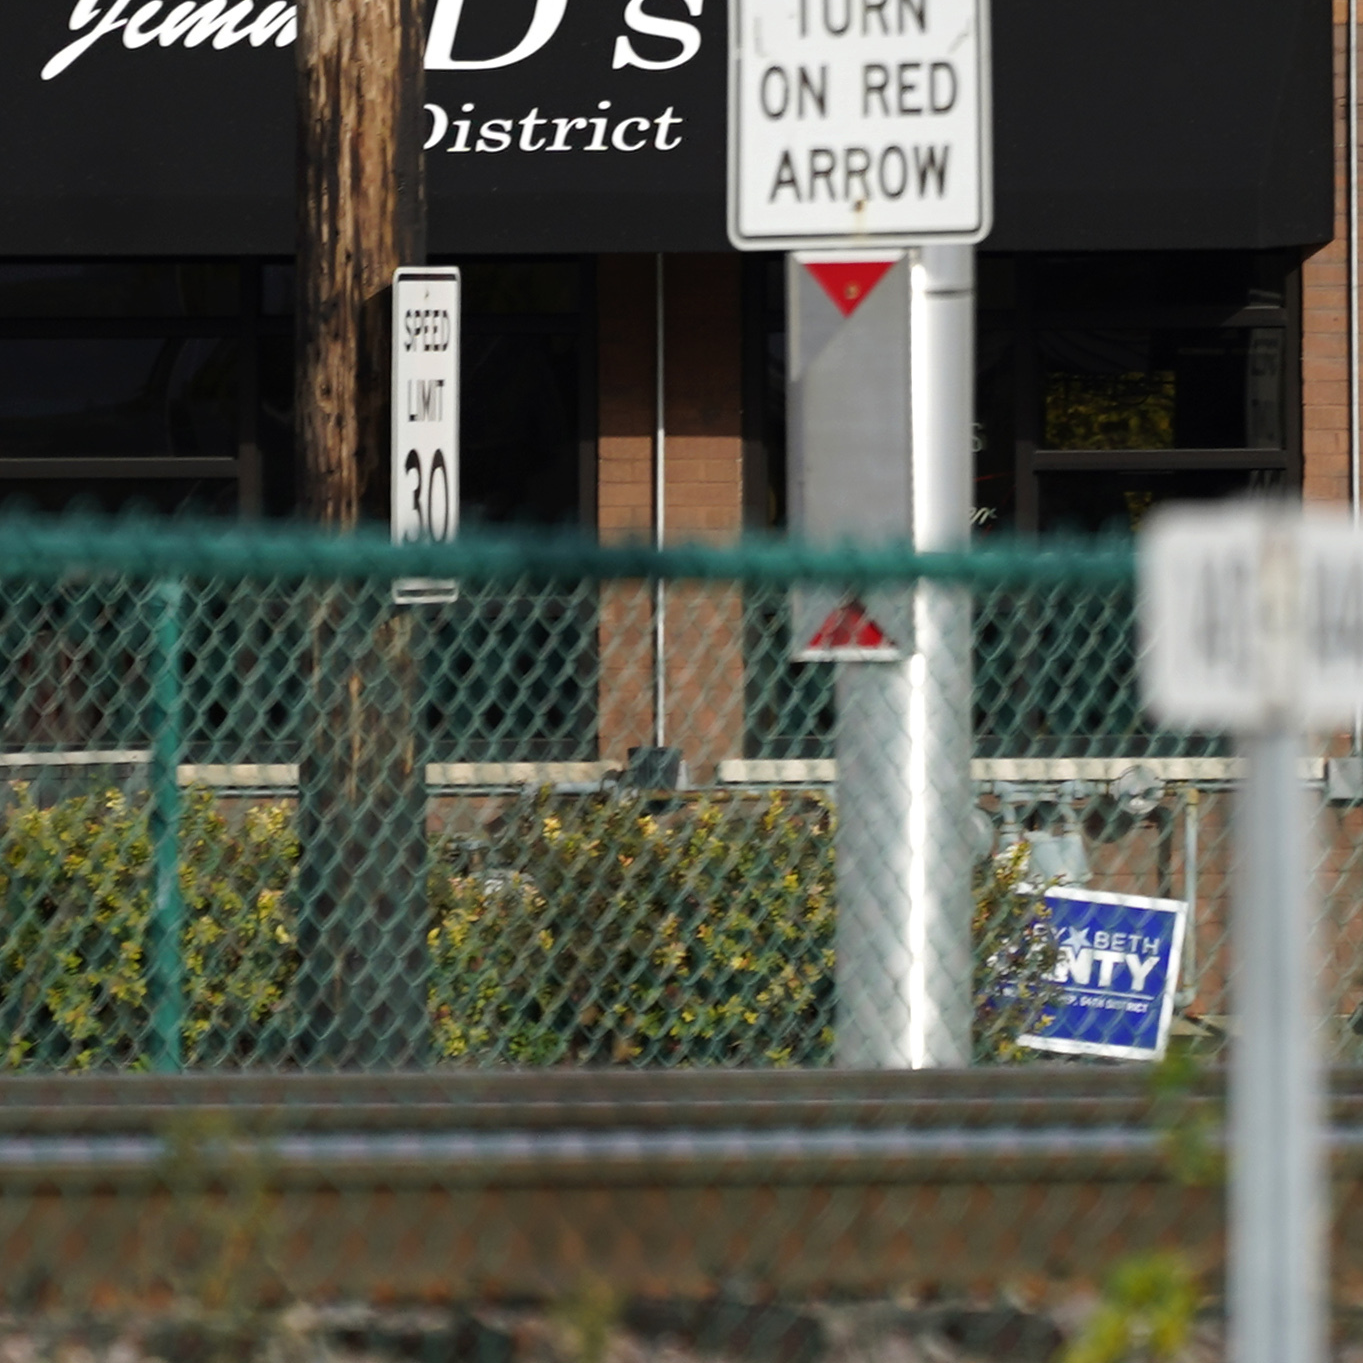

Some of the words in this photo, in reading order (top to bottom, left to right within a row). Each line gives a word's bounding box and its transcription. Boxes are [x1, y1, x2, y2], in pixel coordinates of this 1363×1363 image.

[760, 65, 828, 121] ON
[862, 61, 958, 119] RED
[768, 144, 950, 204] ARROW
[404, 309, 450, 352] SPEED
[407, 379, 445, 422] LIMIT
[404, 448, 450, 543] 30
[1093, 930, 1161, 956] BETH
